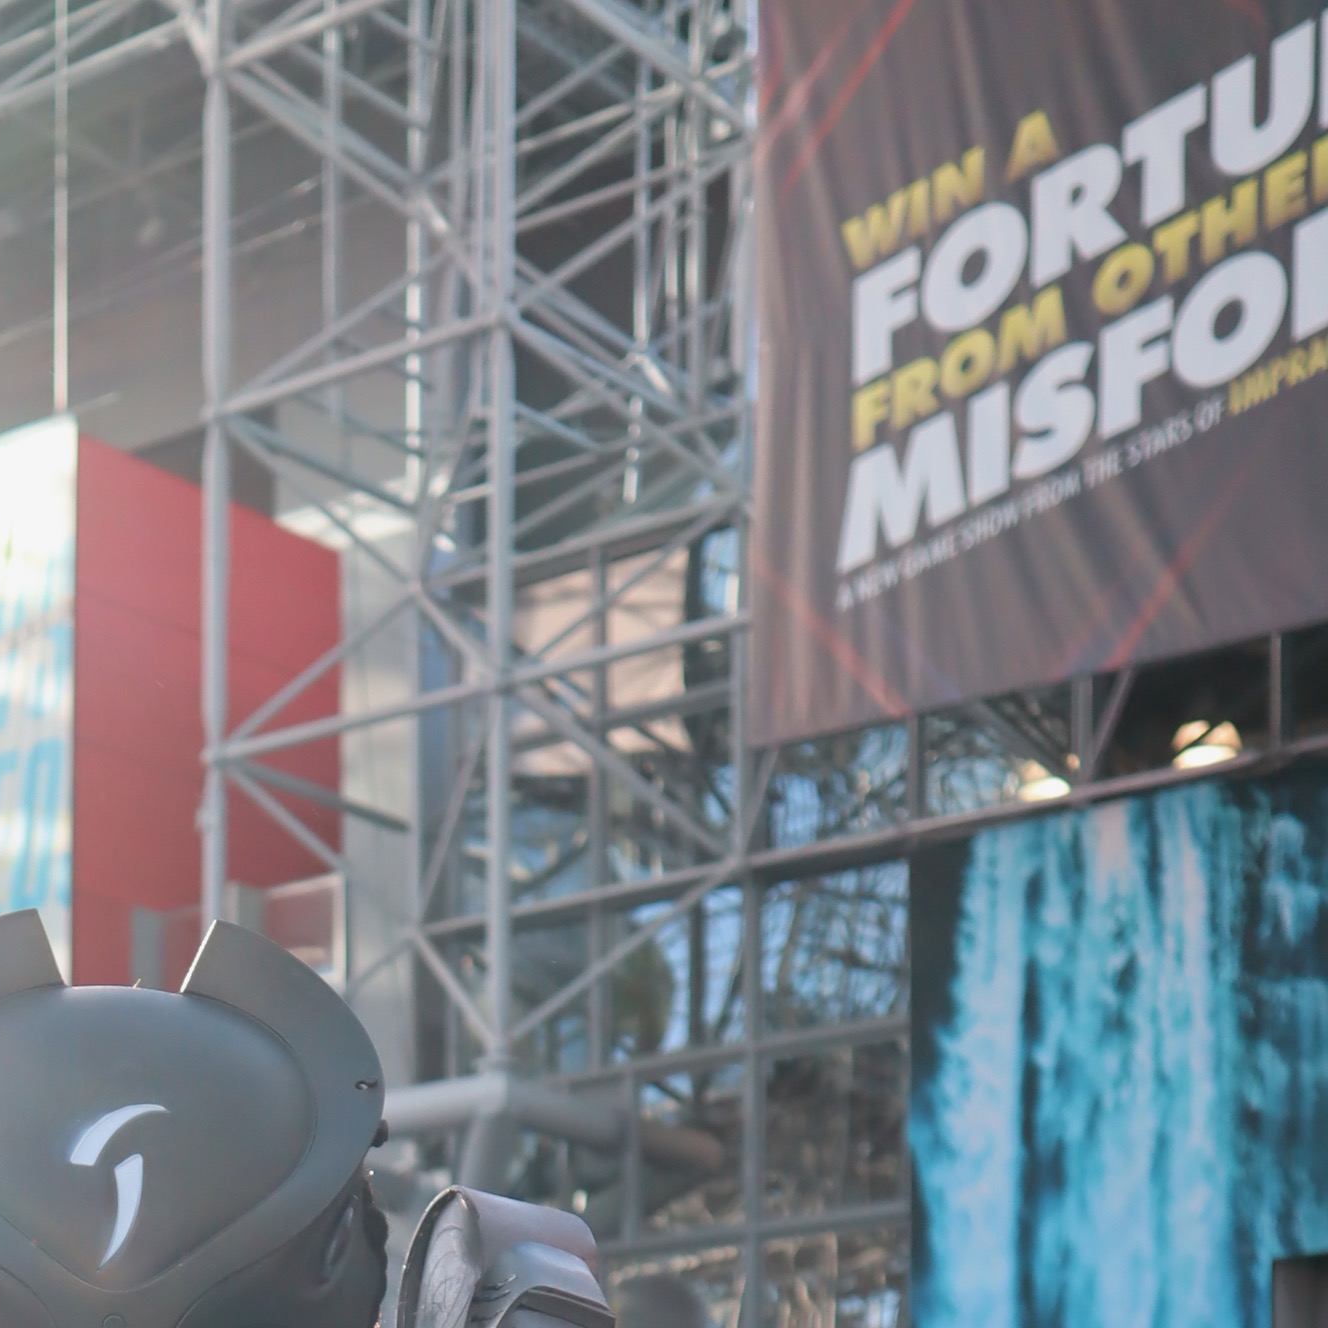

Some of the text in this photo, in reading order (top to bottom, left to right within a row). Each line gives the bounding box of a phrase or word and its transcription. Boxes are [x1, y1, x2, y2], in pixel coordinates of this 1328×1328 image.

[841, 108, 1060, 271] WIN A
[851, 6, 1328, 378] FORTU
[850, 284, 1068, 454] FROM
[1022, 470, 1082, 520] FROM
[1083, 444, 1124, 490] THE
[1124, 407, 1193, 469] STARS
[1193, 391, 1226, 434] OF
